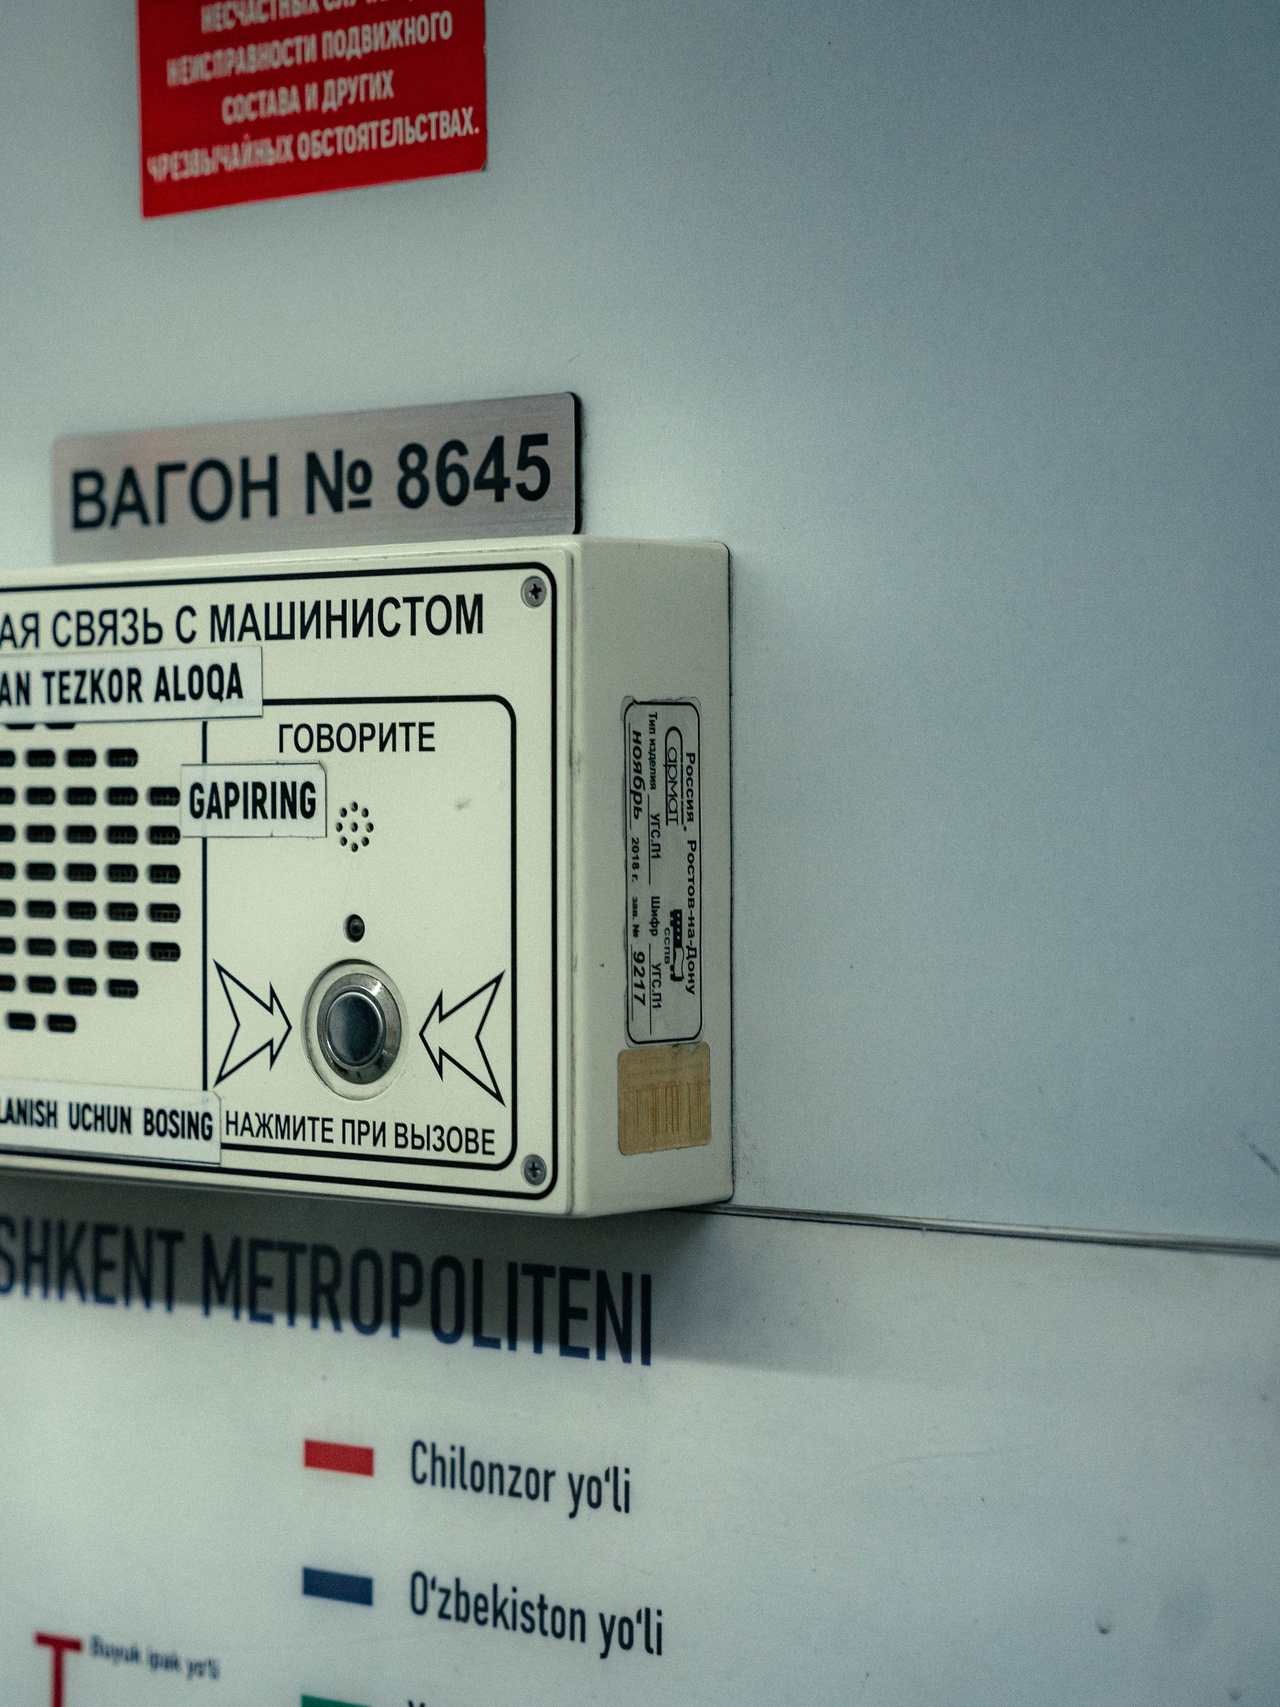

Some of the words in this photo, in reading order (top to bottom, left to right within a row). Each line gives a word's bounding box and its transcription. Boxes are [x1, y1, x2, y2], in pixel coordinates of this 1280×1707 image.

[167, 33, 317, 87] НЕИСПРАВНОСТИ
[322, 11, 453, 60] ПОДВИЖНОГО
[222, 84, 301, 125] СОСТАВА
[305, 83, 318, 112] И
[322, 70, 394, 113] ДРУГИХ
[147, 133, 294, 183] ЧРЕЗВЫЧАЙНЫХ
[298, 106, 479, 161] ОБСТОЯТЕЛЬСТВАХ.
[71, 453, 278, 530] ВАГОН
[306, 449, 372, 514] №
[397, 432, 551, 510] 8645
[51, 607, 164, 648] СВЯЗЬ
[175, 604, 198, 644] С
[210, 594, 485, 643] МАШИНИСТОМ
[42, 666, 142, 705] TEZKOR
[155, 662, 244, 702] ALOQA
[278, 722, 436, 754] ГОВОРИТЕ
[649, 712, 658, 735] Тип
[630, 730, 645, 820] ноябрь
[648, 739, 657, 790] изделия
[685, 752, 695, 822] Россия
[189, 781, 317, 821] GAPIRING
[631, 837, 640, 870] 2018
[650, 813, 661, 859] УГС.П1
[649, 896, 661, 937] Шифр
[686, 840, 697, 996] Ростов-на-Дону
[632, 951, 646, 1006] 9217
[651, 963, 662, 1009] УГС.П1
[68, 1101, 131, 1135] UCHUN
[143, 1107, 213, 1141] BOSING
[225, 1116, 334, 1144] НАЖМИТЕ
[342, 1118, 387, 1149] ПРИ
[394, 1122, 496, 1156] ВЫЗОВЕ
[201, 1232, 652, 1367] METROPOLITENI
[411, 1439, 556, 1502] Chilonzor
